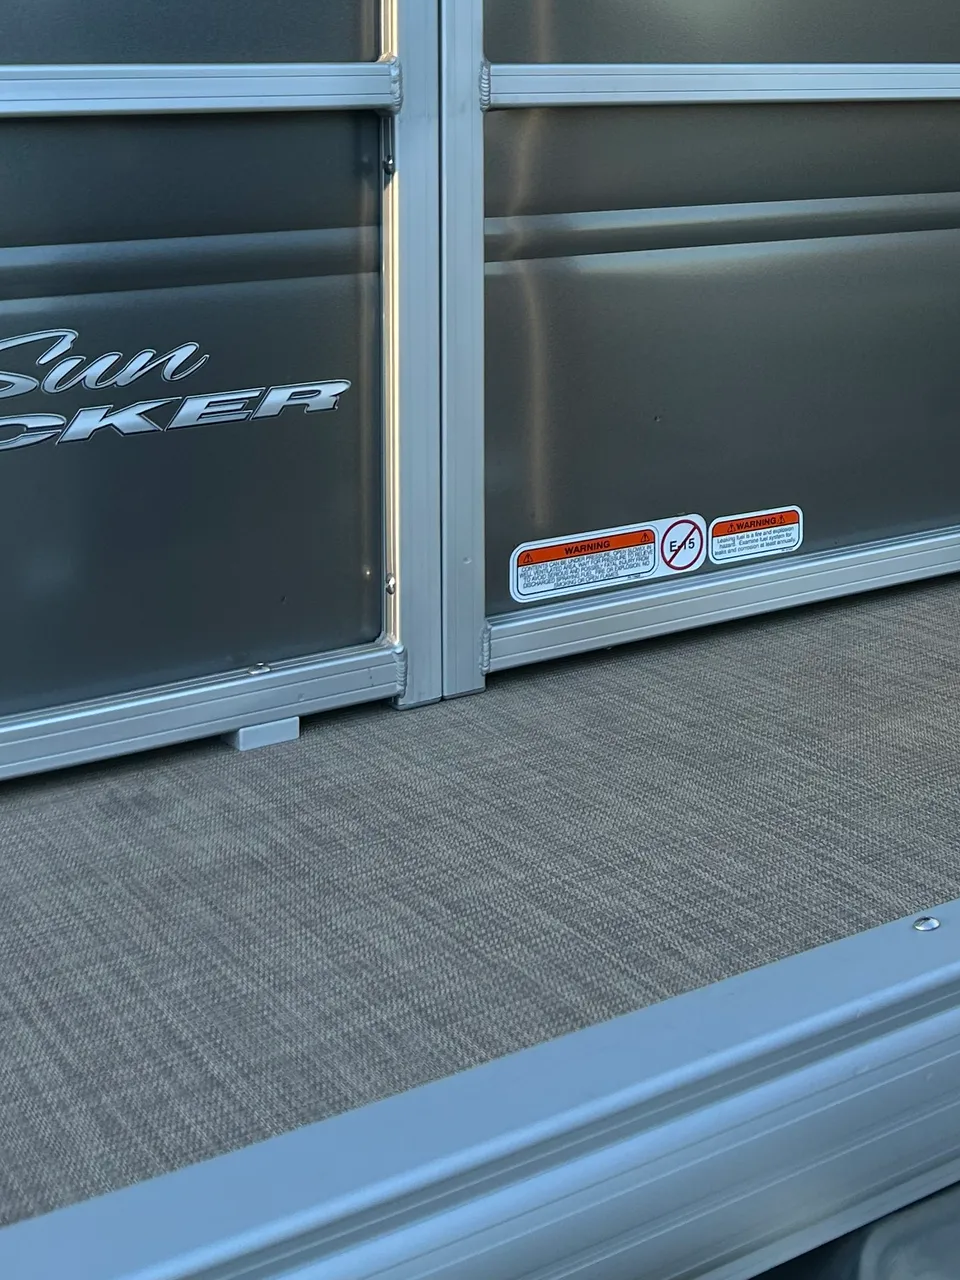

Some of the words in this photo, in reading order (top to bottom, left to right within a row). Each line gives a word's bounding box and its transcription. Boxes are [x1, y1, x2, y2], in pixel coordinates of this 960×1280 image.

[0, 328, 210, 401] Sun
[736, 518, 776, 530] WARNING
[565, 540, 610, 556] WARNING
